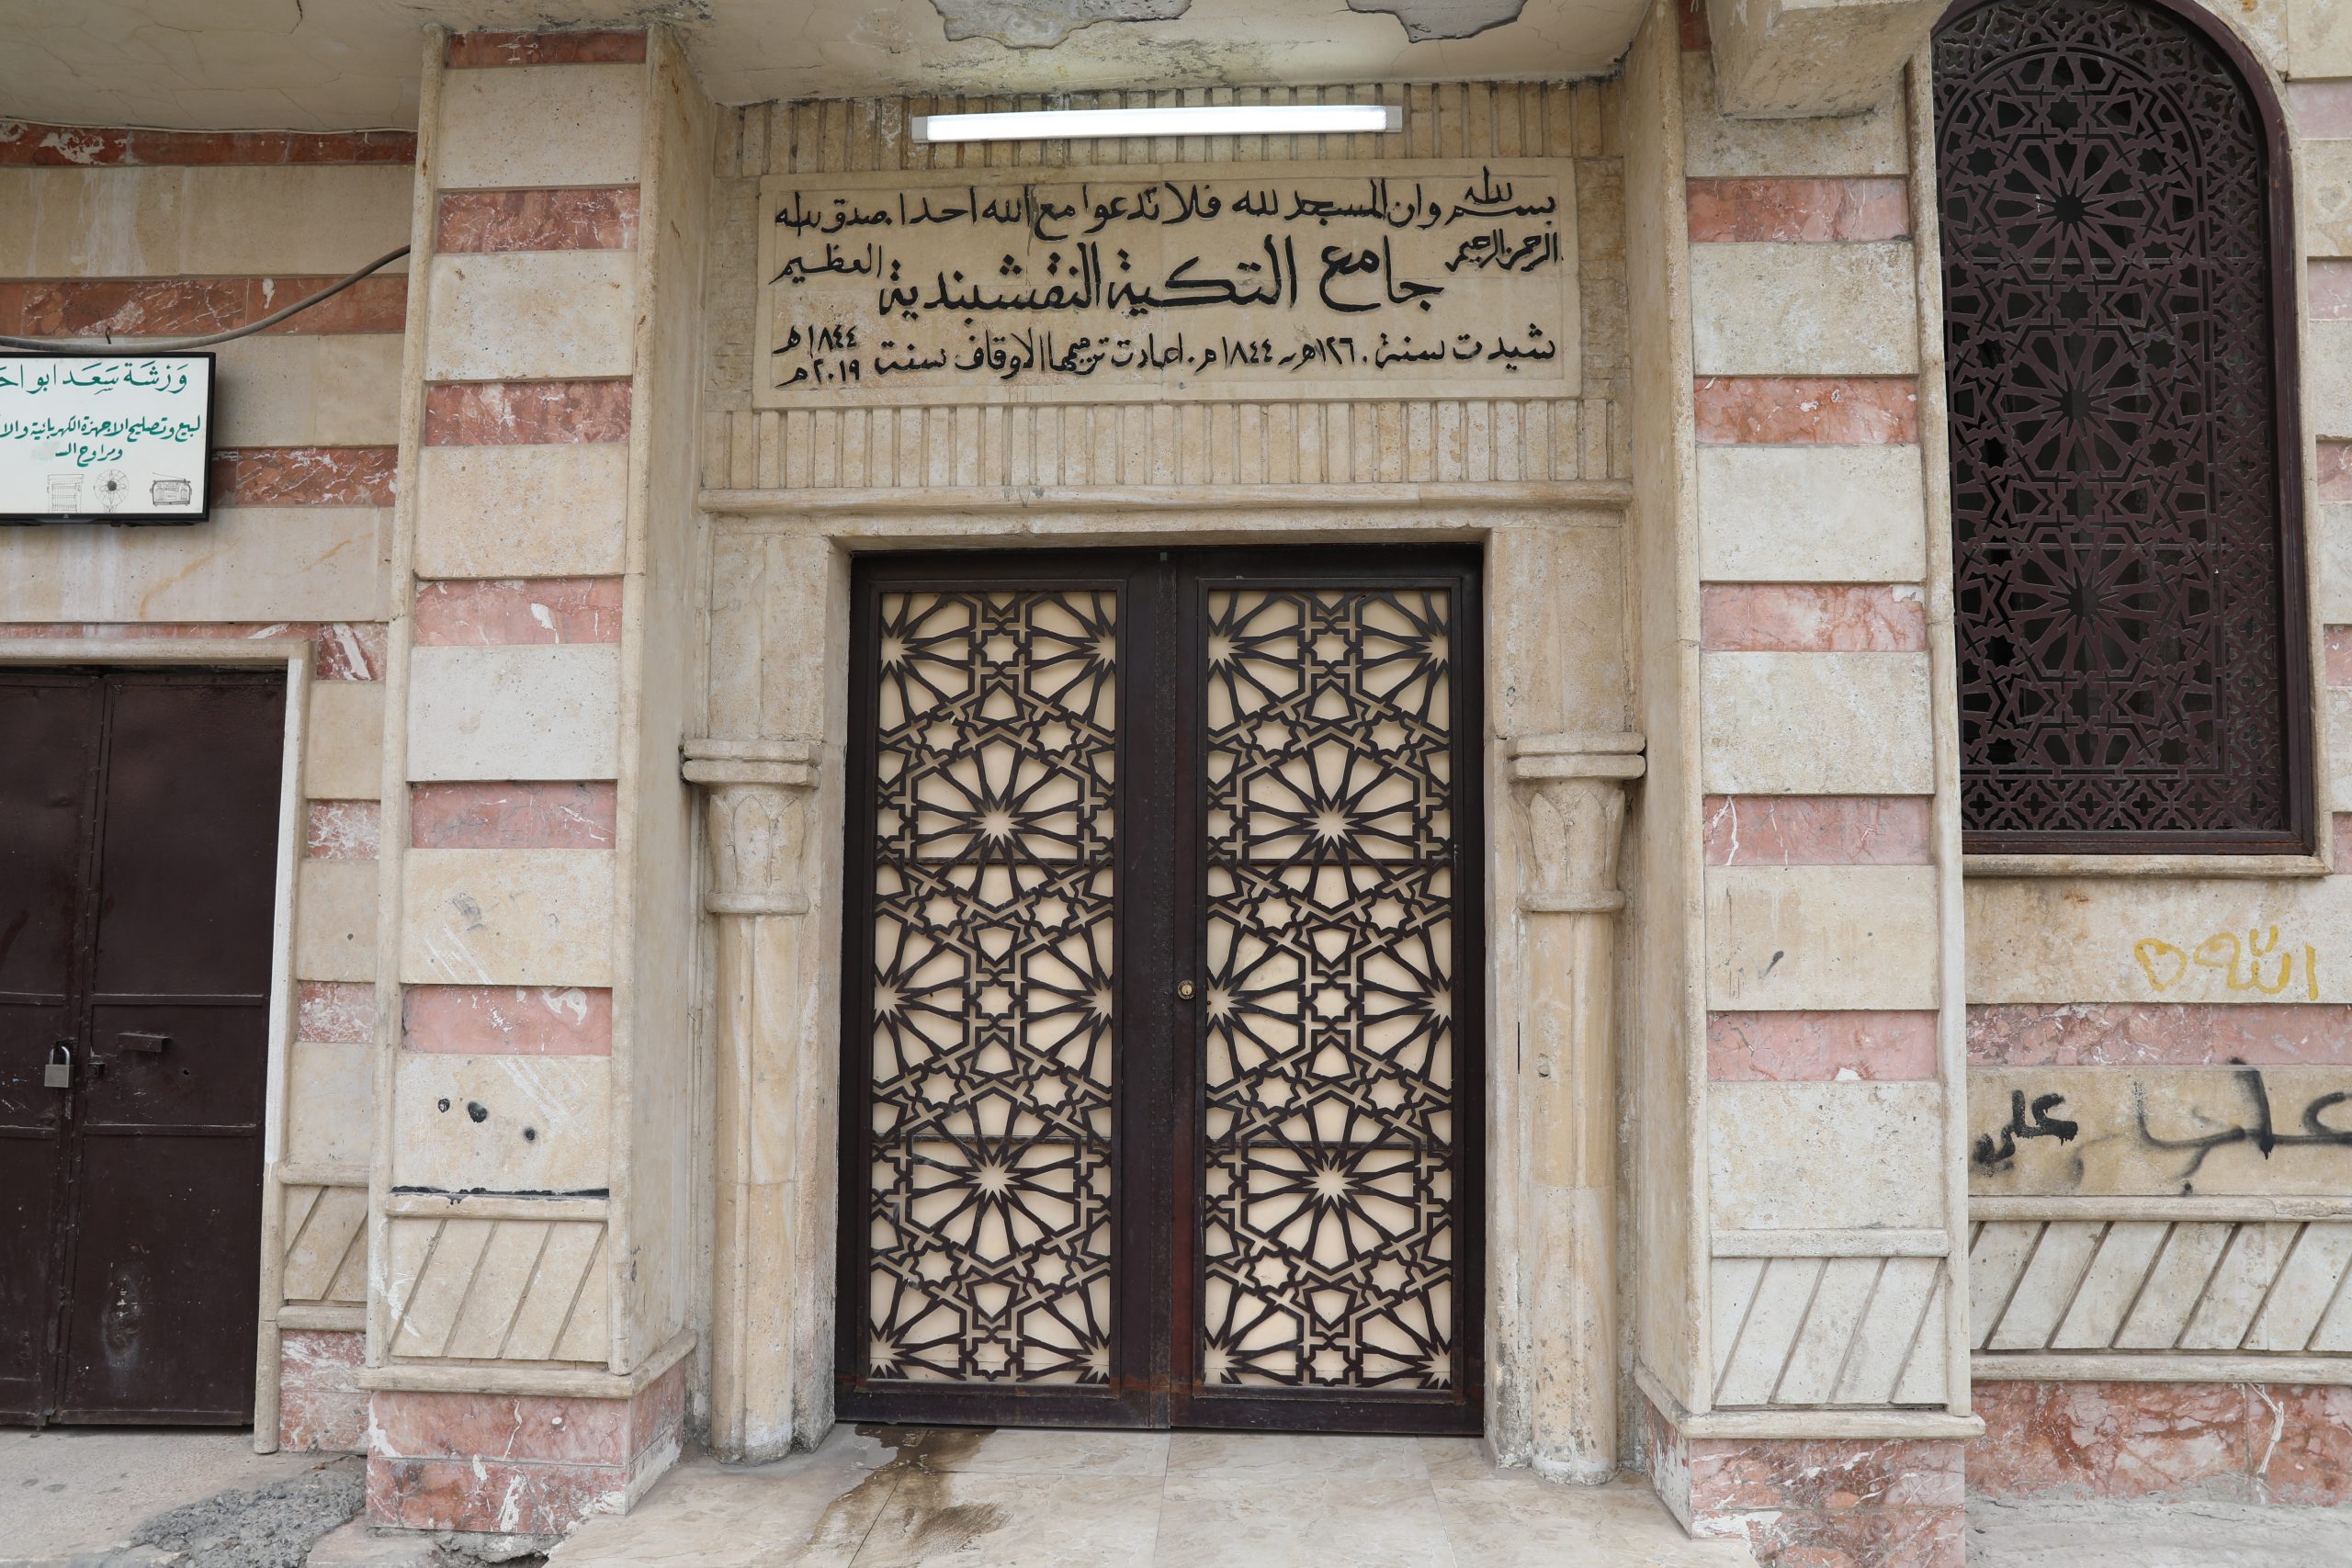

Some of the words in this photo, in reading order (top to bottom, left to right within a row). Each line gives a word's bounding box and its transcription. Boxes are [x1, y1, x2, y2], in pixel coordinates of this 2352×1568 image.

[982, 184, 1031, 228] الله
[1034, 202, 1078, 243] مع
[1081, 183, 1159, 234] تدعوا
[1160, 182, 1222, 225] فلا
[1231, 188, 1280, 217] لله
[1444, 196, 1556, 225] بسم
[768, 243, 882, 286] العظيم
[1444, 228, 1506, 273] الرحيم
[1495, 231, 1559, 272] الرحمن
[878, 242, 1102, 325] النقشبندية
[1107, 233, 1297, 316] التكية
[1319, 235, 1445, 312] جامع
[955, 327, 1045, 380] الاوقاف
[26, 364, 57, 394] ابو
[127, 415, 175, 443] وتصليح
[175, 414, 200, 443] لبيع
[76, 444, 123, 468] ومراوح
